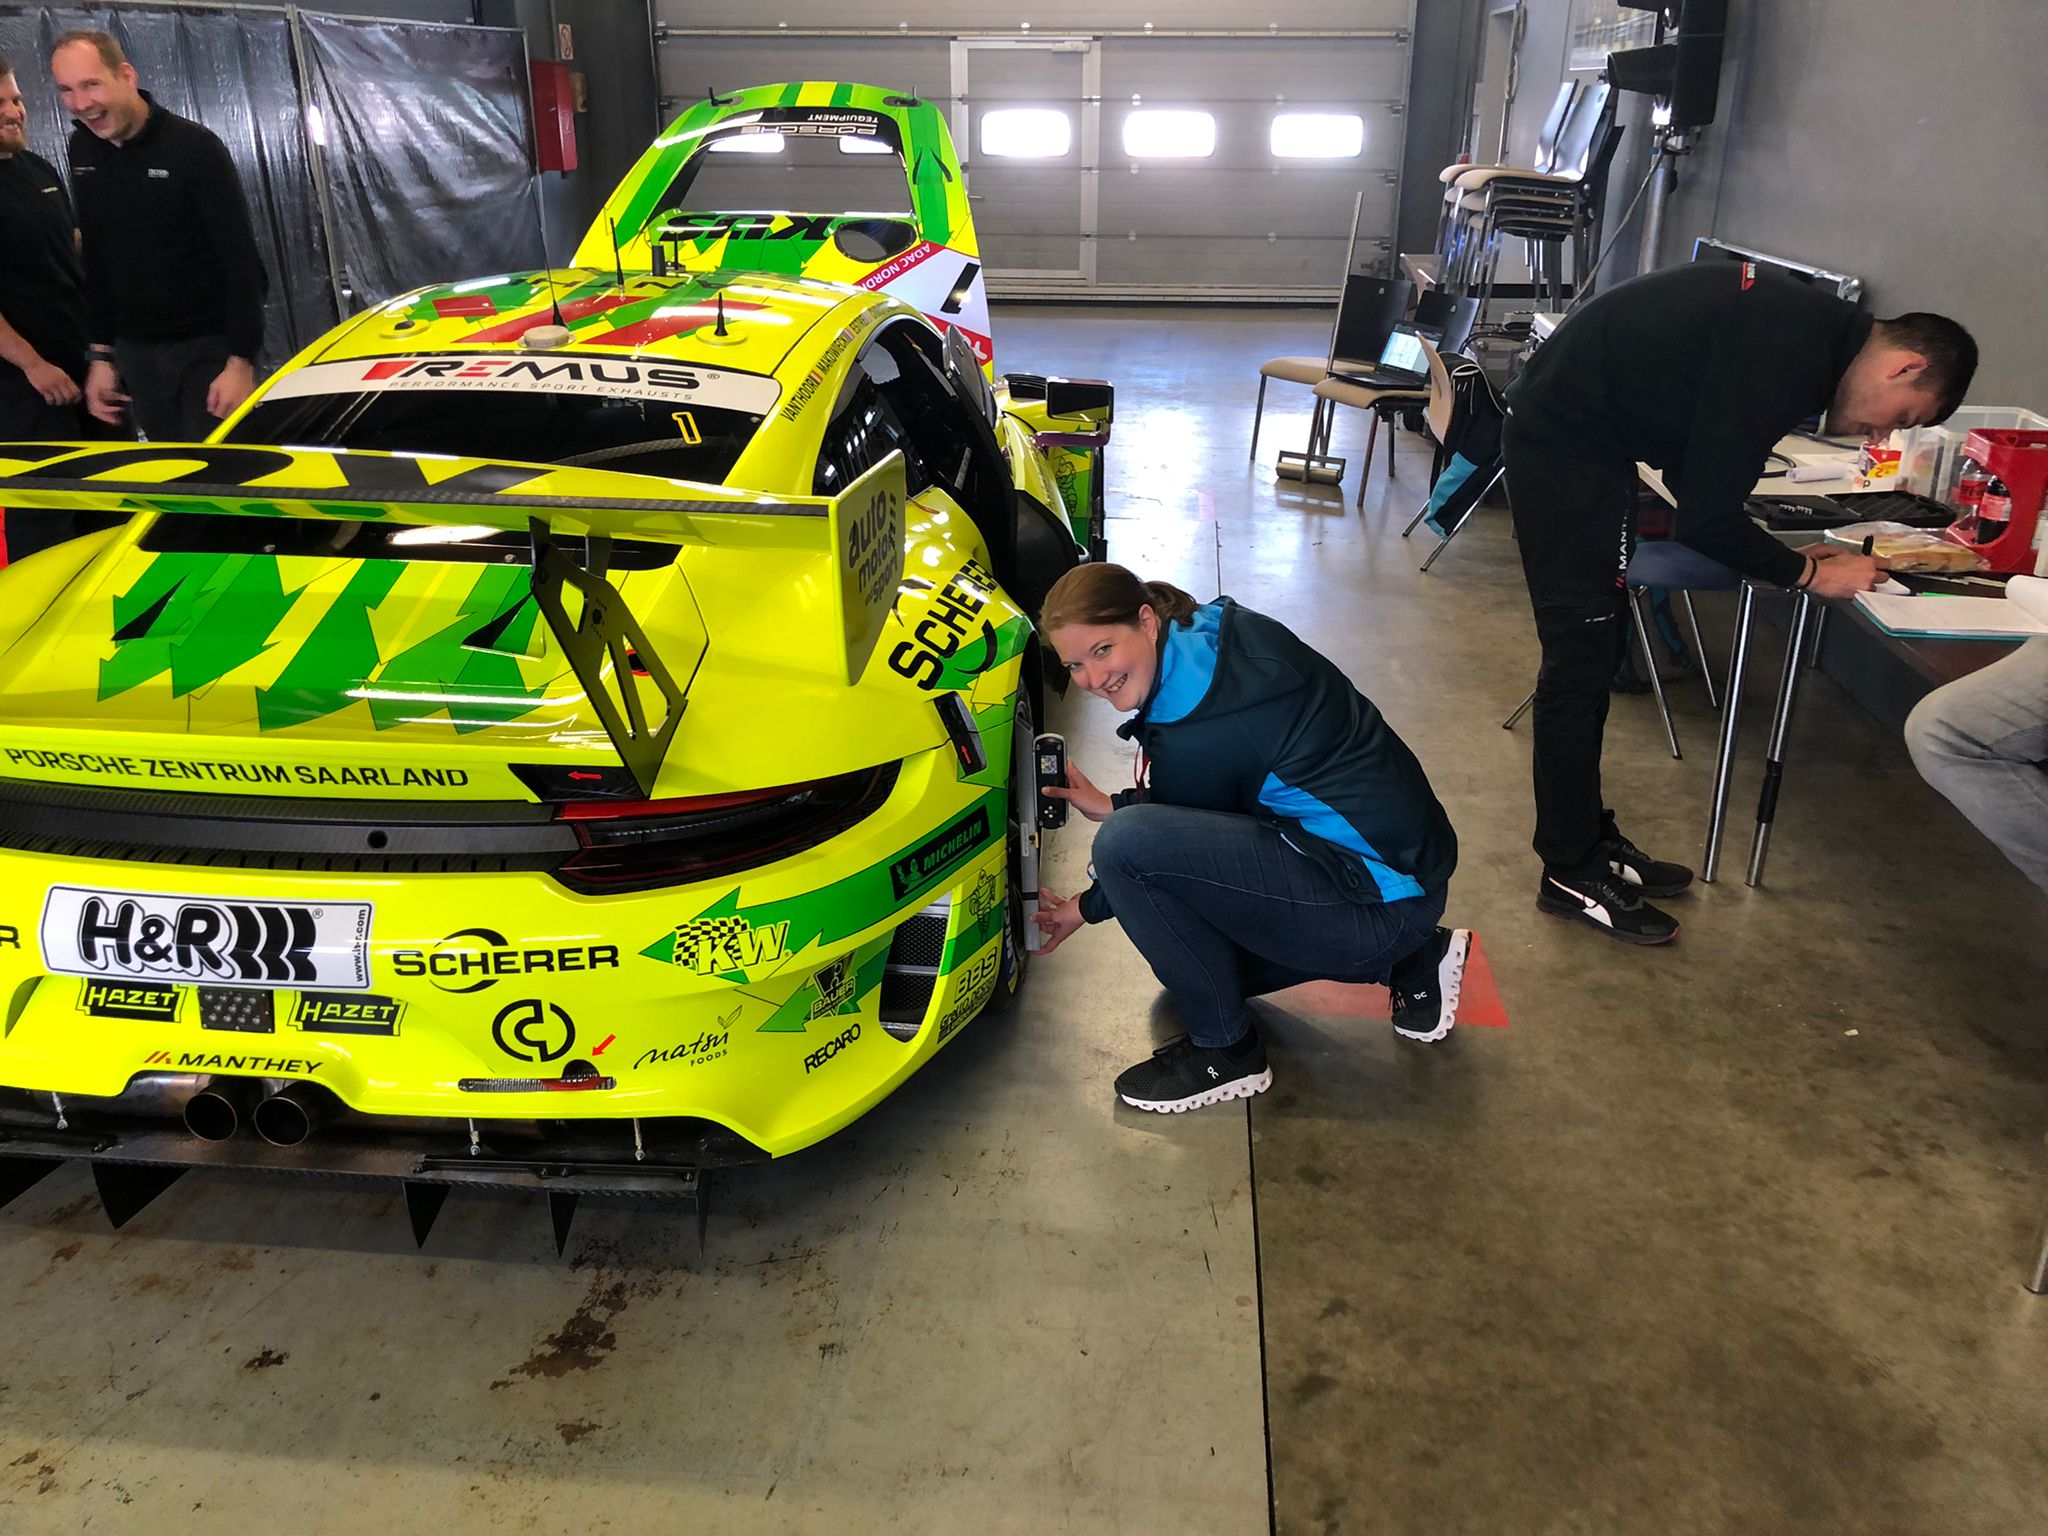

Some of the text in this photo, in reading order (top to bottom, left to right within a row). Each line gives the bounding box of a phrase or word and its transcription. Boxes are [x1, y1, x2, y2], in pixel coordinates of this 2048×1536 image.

[741, 125, 876, 135] PORSCHE
[807, 114, 879, 124] TEQUIPMENT
[902, 242, 931, 268] ADAC
[940, 262, 981, 314] 1
[388, 381, 694, 400] PERFORMANCE SPORT EXHAUSTS
[401, 360, 700, 389] REMUS
[671, 411, 702, 445] 1
[848, 489, 887, 569] auto
[4, 748, 469, 787] PORSCHE ZENTRUM SAARLAND
[924, 821, 982, 872] MICHELIN
[79, 897, 232, 977] H&R
[356, 908, 367, 983] www.h-r.com
[697, 922, 788, 976] KW
[393, 945, 619, 977] SCHERER
[954, 946, 998, 1004] BBS
[87, 985, 175, 1008] HAZET
[300, 1001, 395, 1022] HAZET
[814, 980, 854, 1013] BAUER
[178, 1053, 323, 1074] MANTHEY
[690, 1050, 728, 1066] FOODS
[803, 1023, 861, 1074] RECARO
